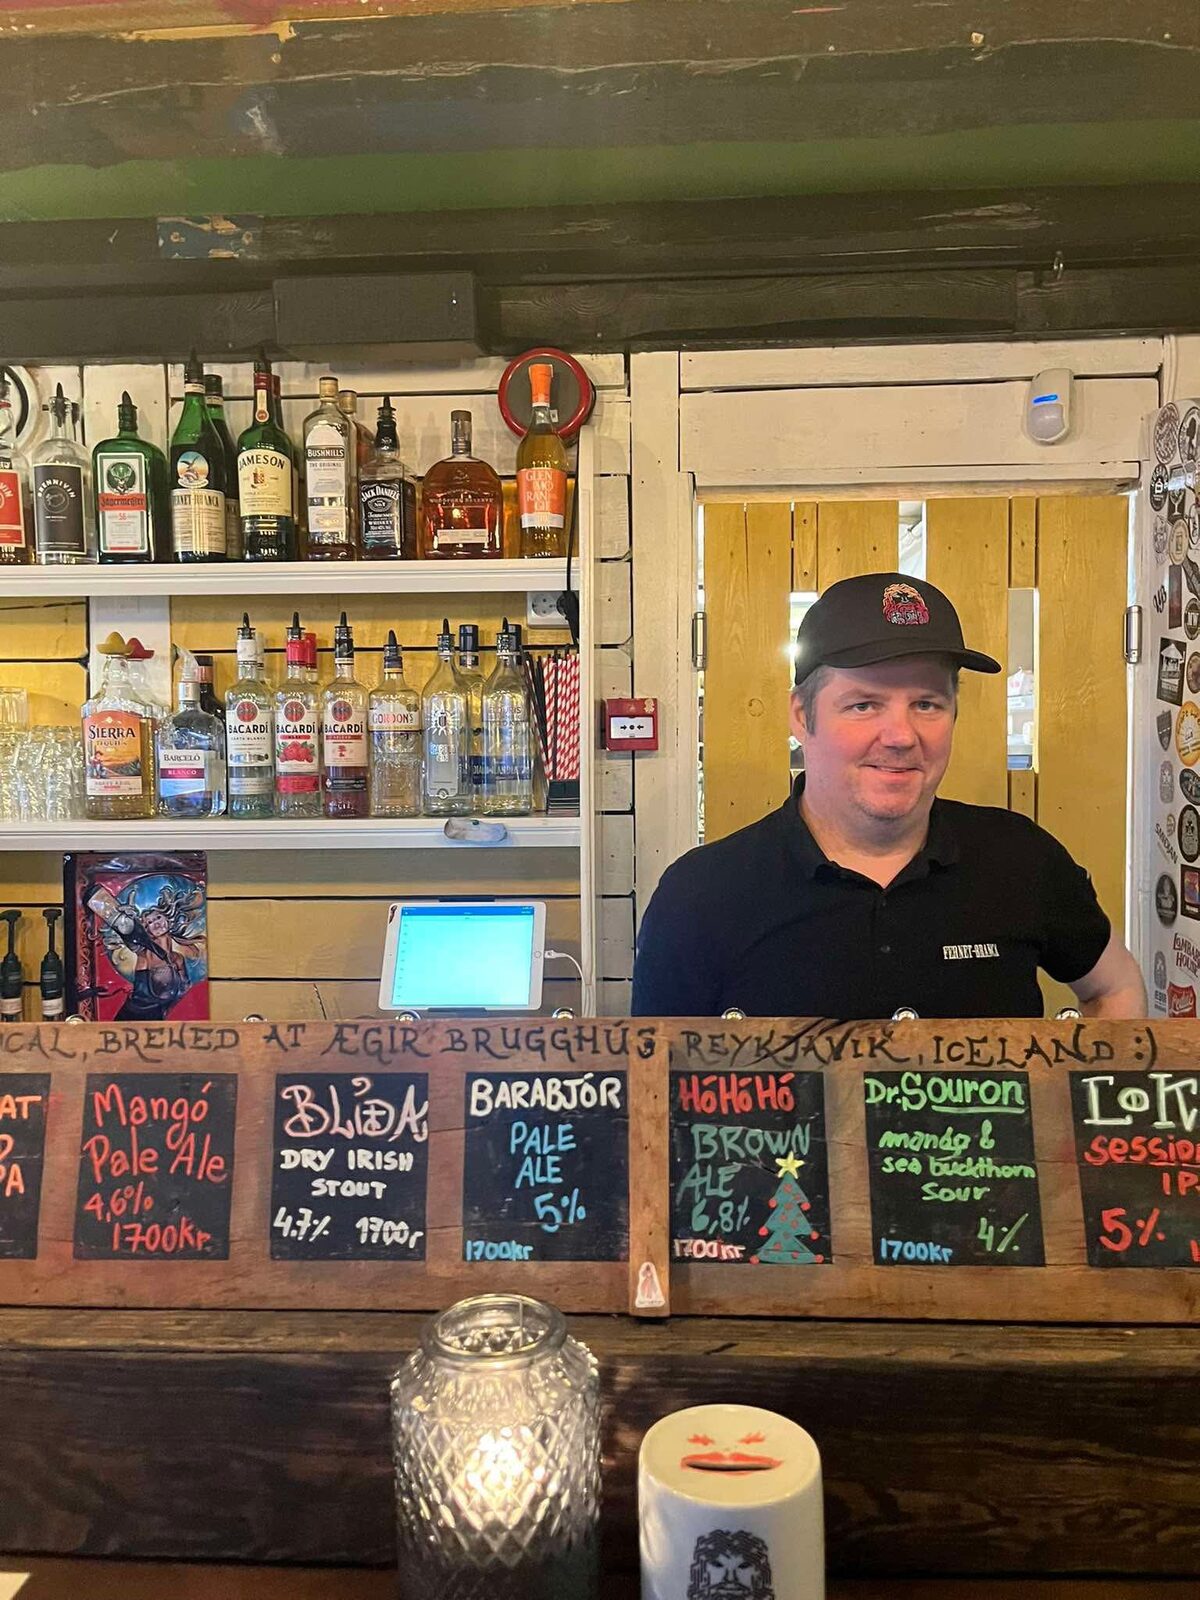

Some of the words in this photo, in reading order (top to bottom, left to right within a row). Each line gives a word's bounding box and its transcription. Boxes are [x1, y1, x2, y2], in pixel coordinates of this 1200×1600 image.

[238, 454, 286, 471] JAMESON
[307, 449, 344, 457] BUSHMILLS
[228, 721, 269, 734] BACARDÍ
[276, 721, 316, 734] BACARDÍ
[324, 721, 364, 734] BACARDÍ
[0, 1024, 88, 1062] CAL,
[94, 1022, 241, 1064] BREWED
[262, 1022, 307, 1053] AT
[932, 1023, 1115, 1069] ICELAND
[93, 1081, 213, 1150] Mangó
[82, 1125, 160, 1184] Pale
[169, 1132, 228, 1184] Ale
[509, 1120, 577, 1156] PALE
[691, 1123, 811, 1160] BROWN
[280, 1148, 335, 1172] DRY
[347, 1148, 414, 1172] IRISH
[515, 1154, 564, 1189] ALE
[311, 1178, 387, 1199] STOUT
[675, 1162, 743, 1207] ALE
[533, 1188, 587, 1233] 5%
[977, 1212, 1029, 1254] 4%
[1099, 1207, 1166, 1253] 5%
